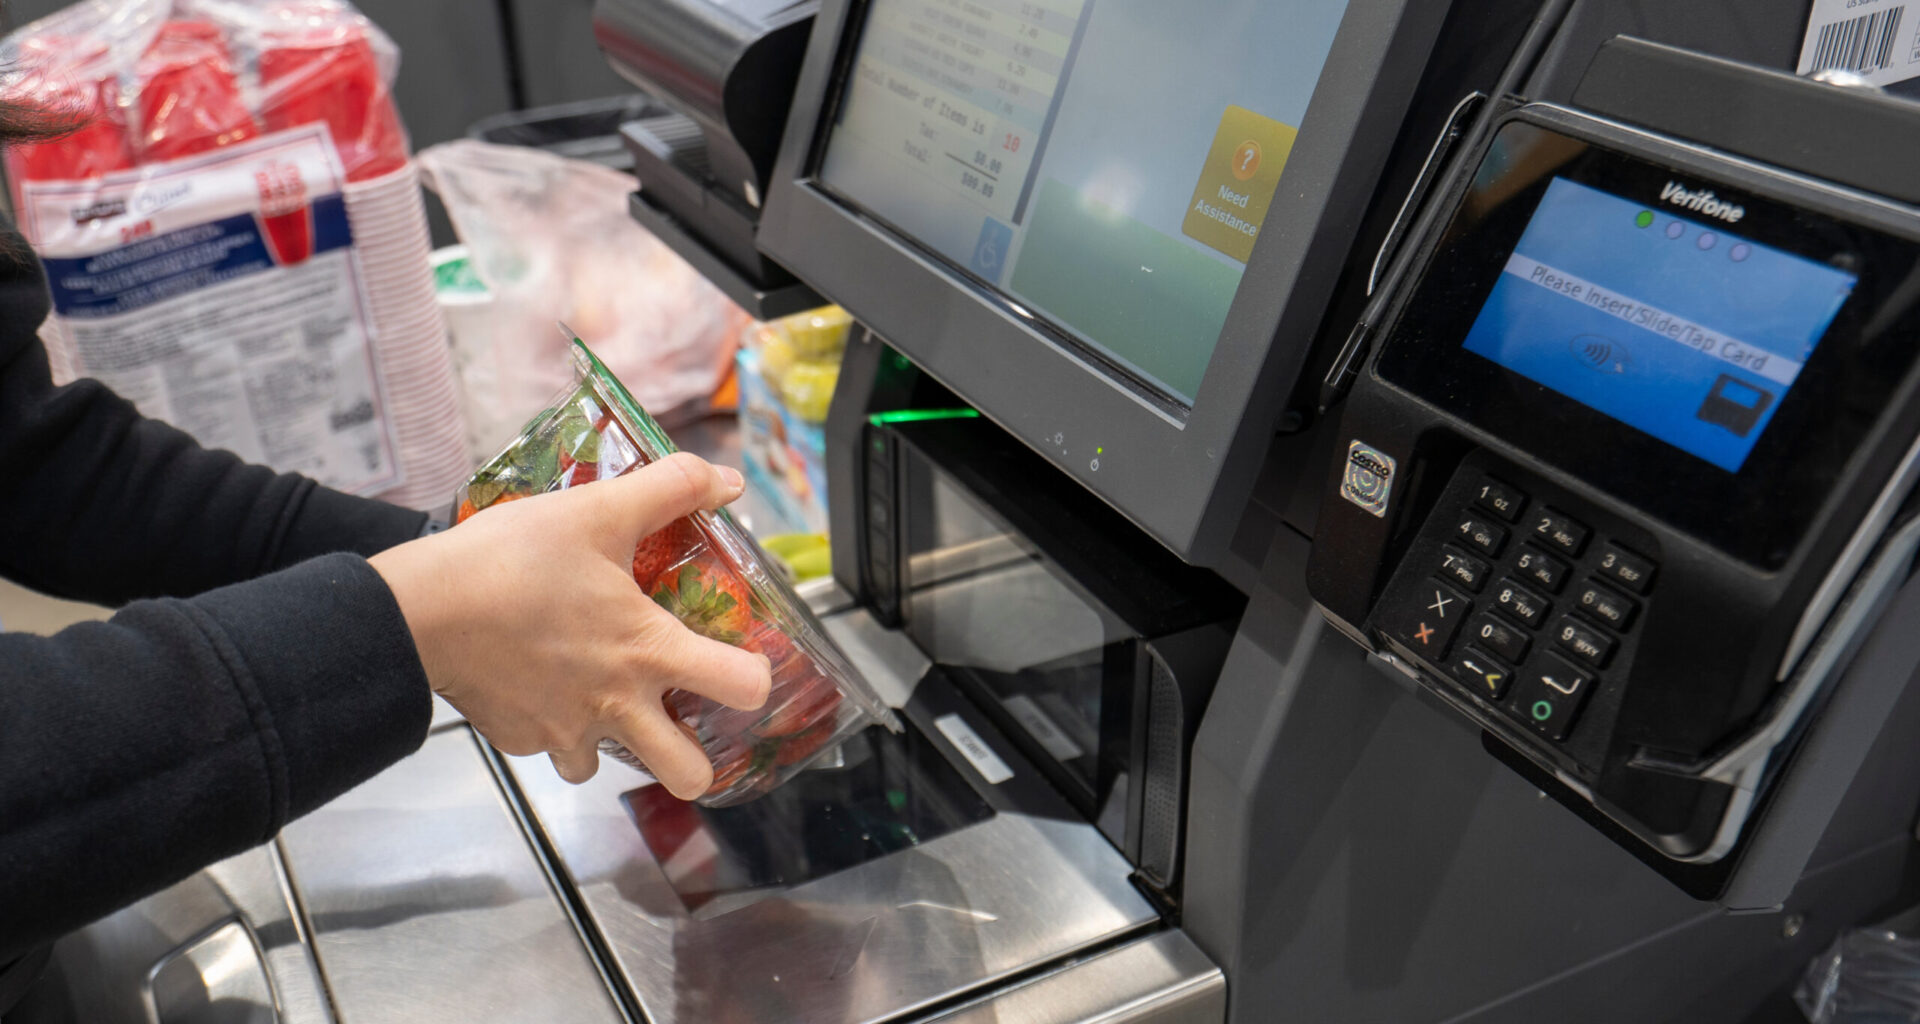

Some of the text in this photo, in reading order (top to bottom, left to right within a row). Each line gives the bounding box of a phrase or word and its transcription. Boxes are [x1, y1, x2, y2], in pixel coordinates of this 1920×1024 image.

[922, 96, 937, 110] of
[939, 101, 969, 127] Items
[972, 118, 985, 135] is
[1002, 132, 1021, 153] 10
[1217, 184, 1250, 208] Need
[1659, 180, 1745, 224] Verifone
[1194, 199, 1257, 236] Assistance
[1531, 264, 1769, 372] Please Insert/Slide/Tap Card
[1352, 451, 1390, 476] COSTCO
[1480, 486, 1490, 499] 1
[1460, 521, 1491, 546] 4 GHI
[1537, 518, 1574, 546] 2 ABC
[1443, 554, 1474, 583] 7 PRS
[1518, 554, 1551, 583] 5 JKL
[1602, 553, 1640, 581] 3 DEF
[1500, 589, 1535, 618] 8 TUV
[1582, 590, 1620, 621] 6 MNO
[1481, 624, 1493, 638] 0
[1561, 626, 1599, 657] 9 WXY
